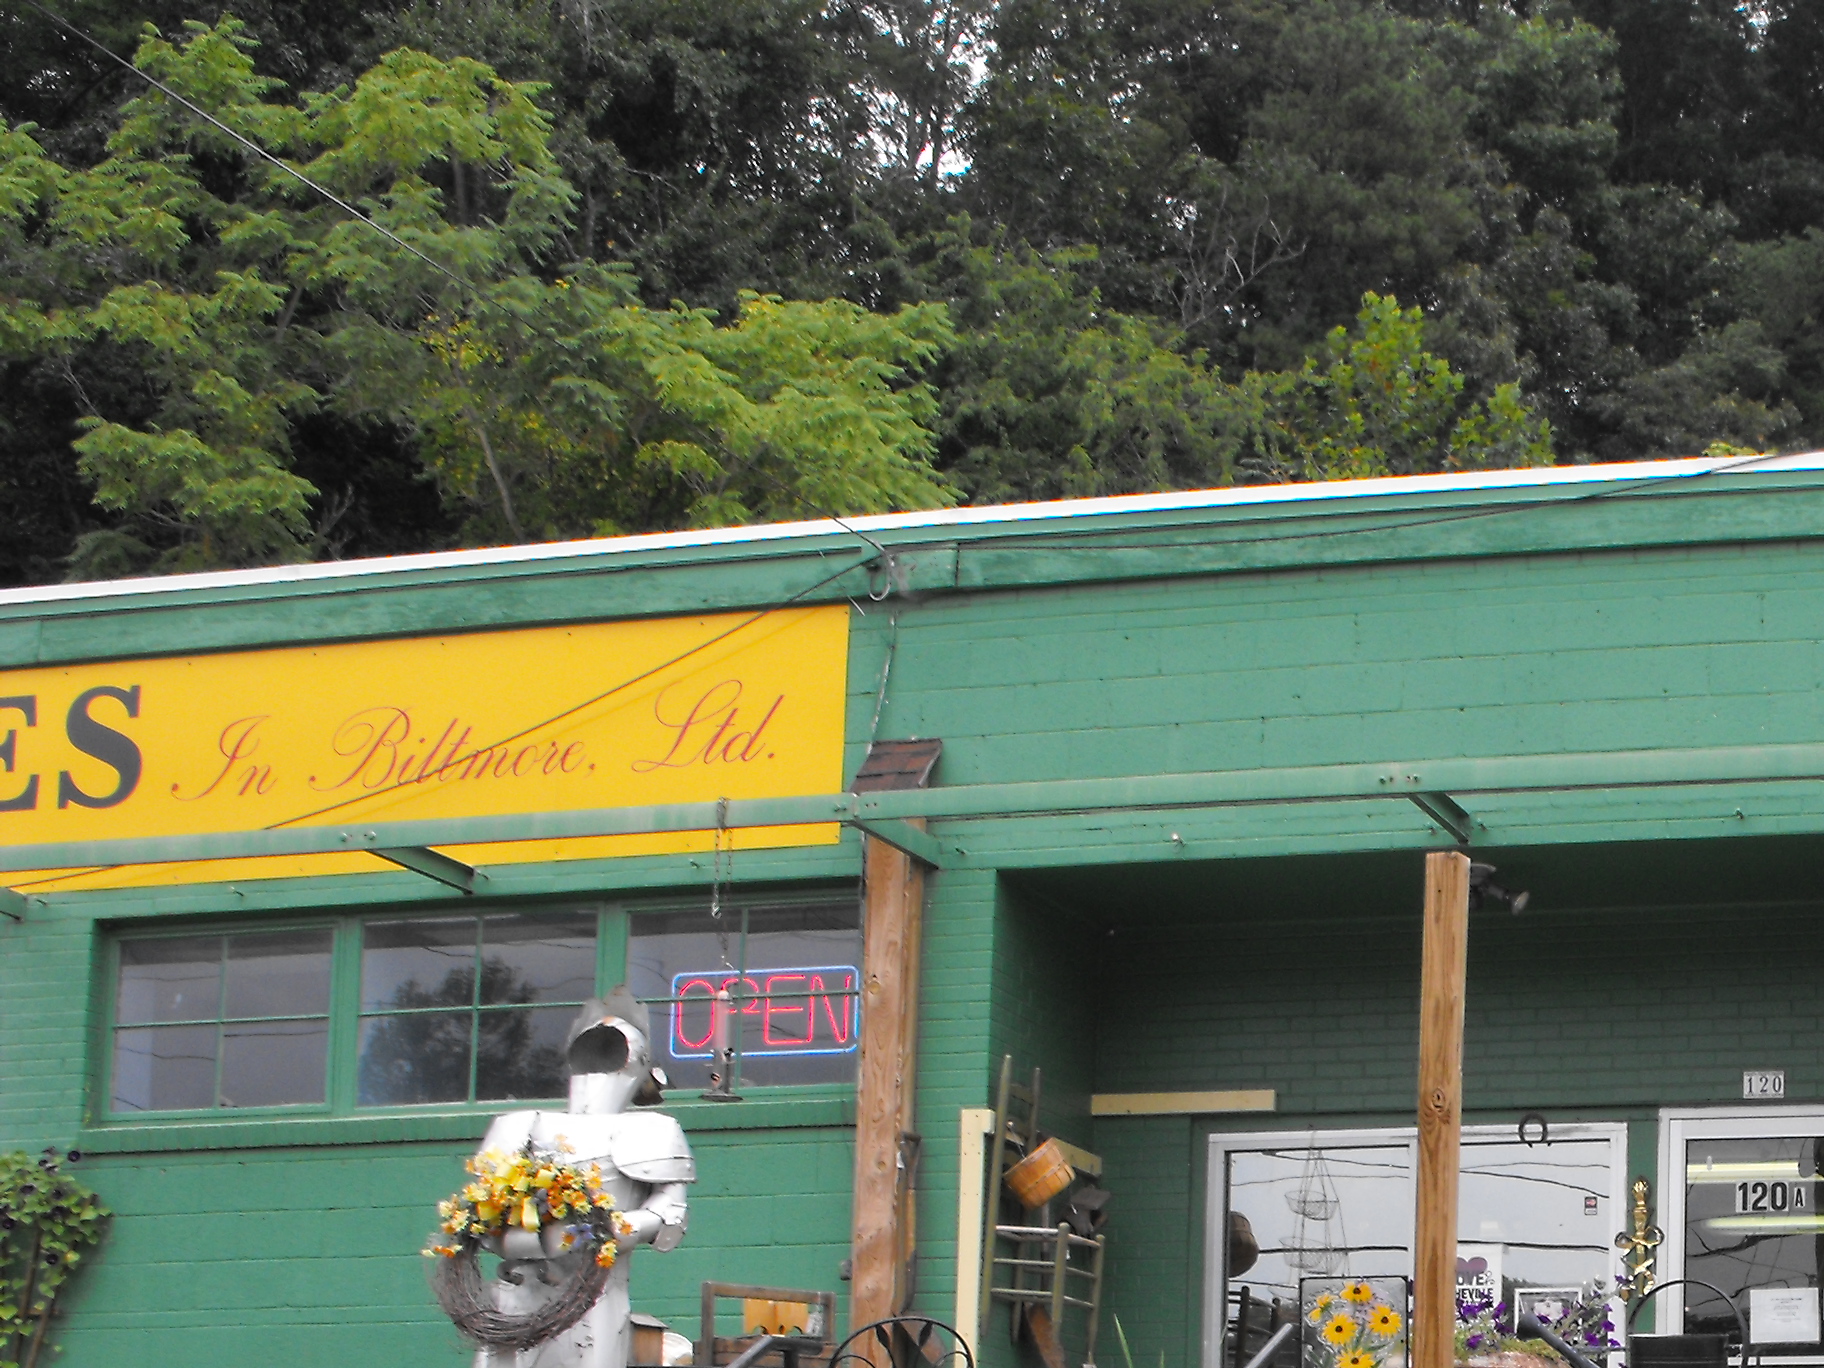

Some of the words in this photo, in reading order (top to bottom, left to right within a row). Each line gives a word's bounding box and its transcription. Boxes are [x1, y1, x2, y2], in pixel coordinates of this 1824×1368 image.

[170, 714, 279, 801] In
[308, 706, 597, 792] Biltmore,
[631, 679, 785, 774] Ltd.
[677, 974, 852, 1048] OPEN
[1746, 1075, 1783, 1093] 120
